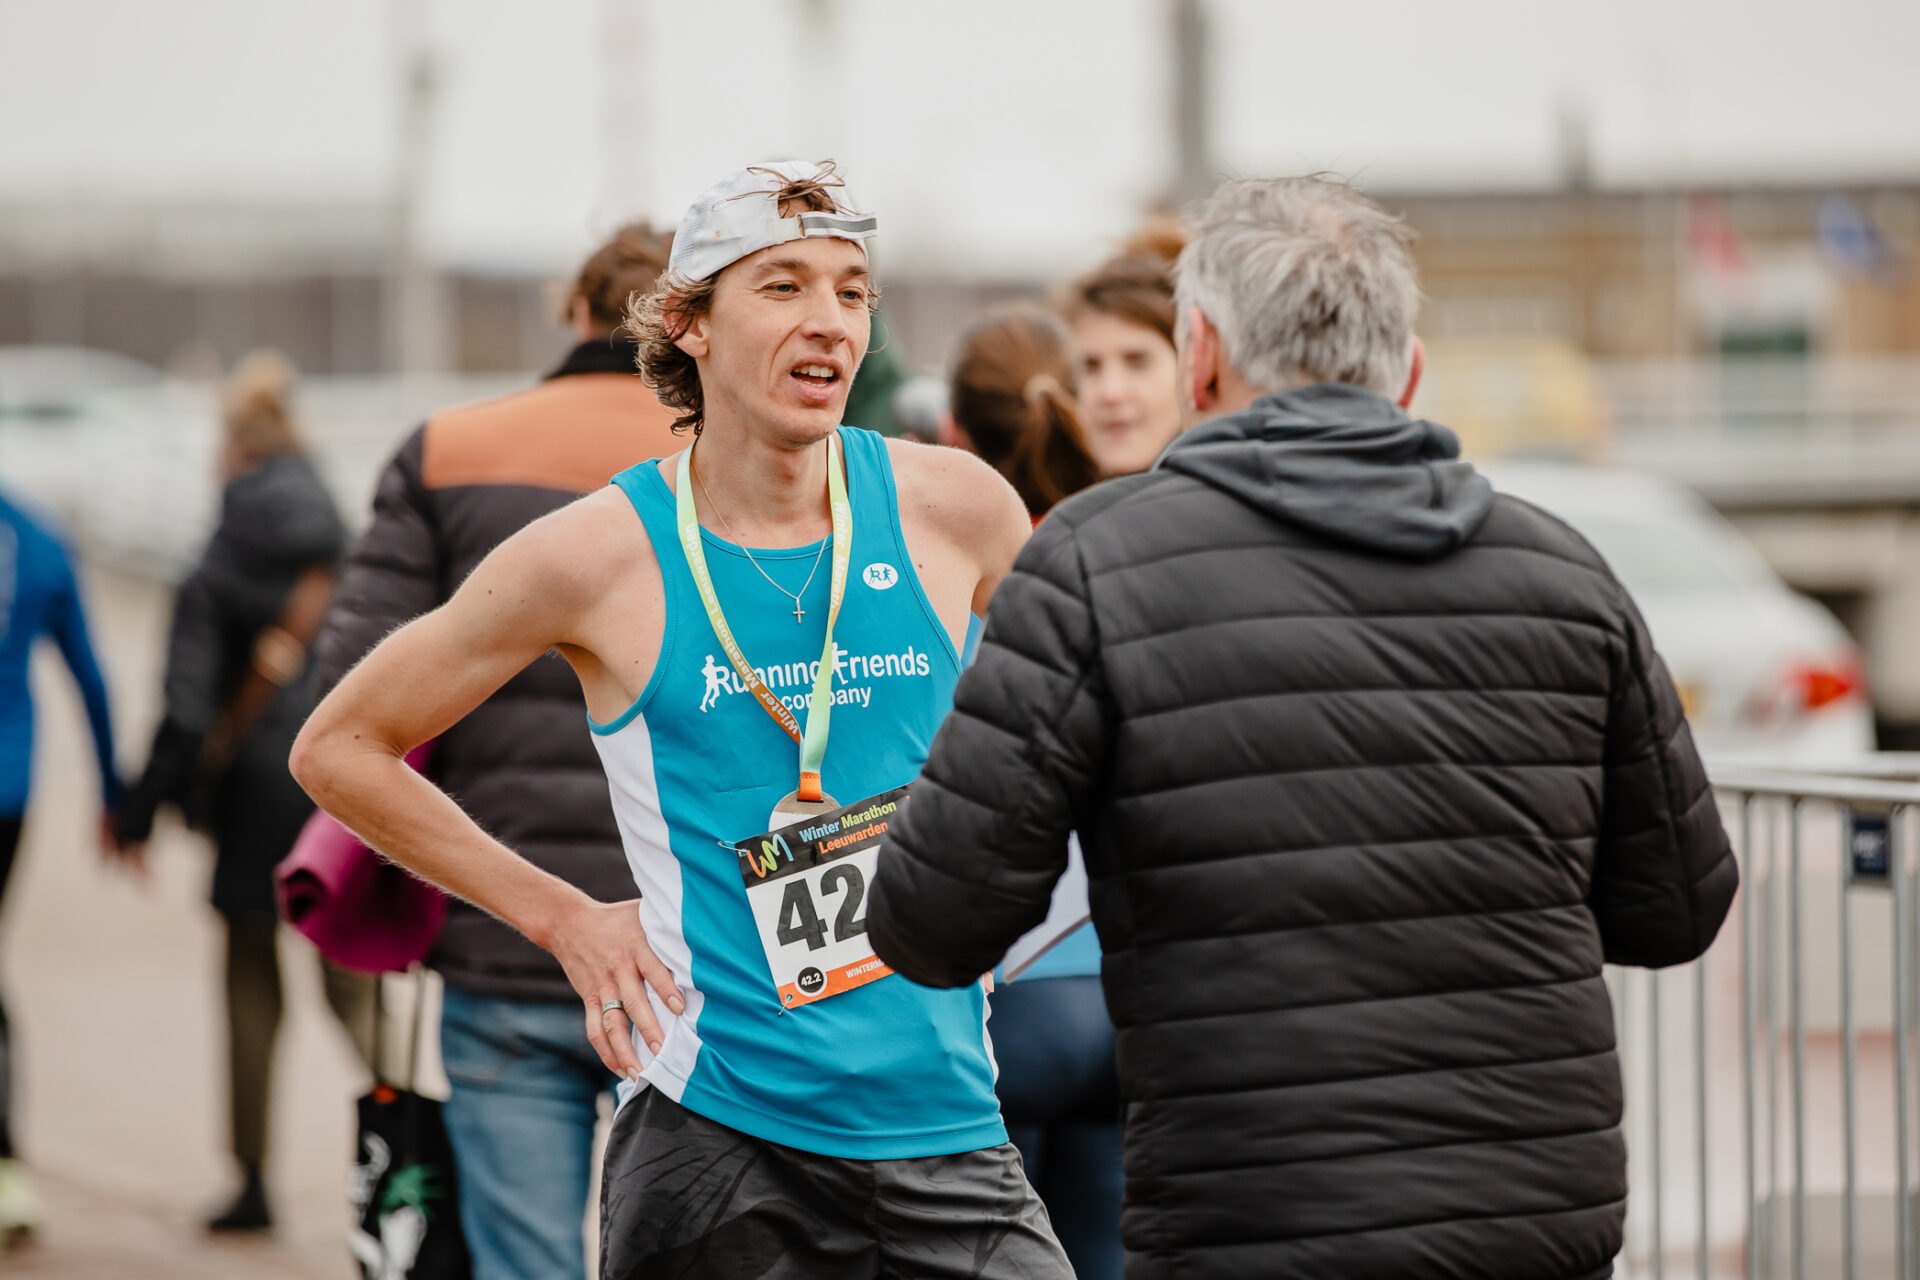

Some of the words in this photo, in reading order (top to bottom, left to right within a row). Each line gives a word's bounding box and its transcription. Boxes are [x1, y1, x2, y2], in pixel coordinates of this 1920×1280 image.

[833, 502, 850, 549] Winter
[685, 522, 719, 616] Leeuwarden
[716, 618, 760, 690] Marathon
[831, 642, 931, 685] Friends
[760, 691, 799, 735] Winter
[799, 821, 840, 843] Winter
[840, 801, 897, 829] Marathon
[818, 822, 888, 854] Leeuwarden
[776, 863, 868, 952] 42
[800, 972, 822, 986] 42.2
